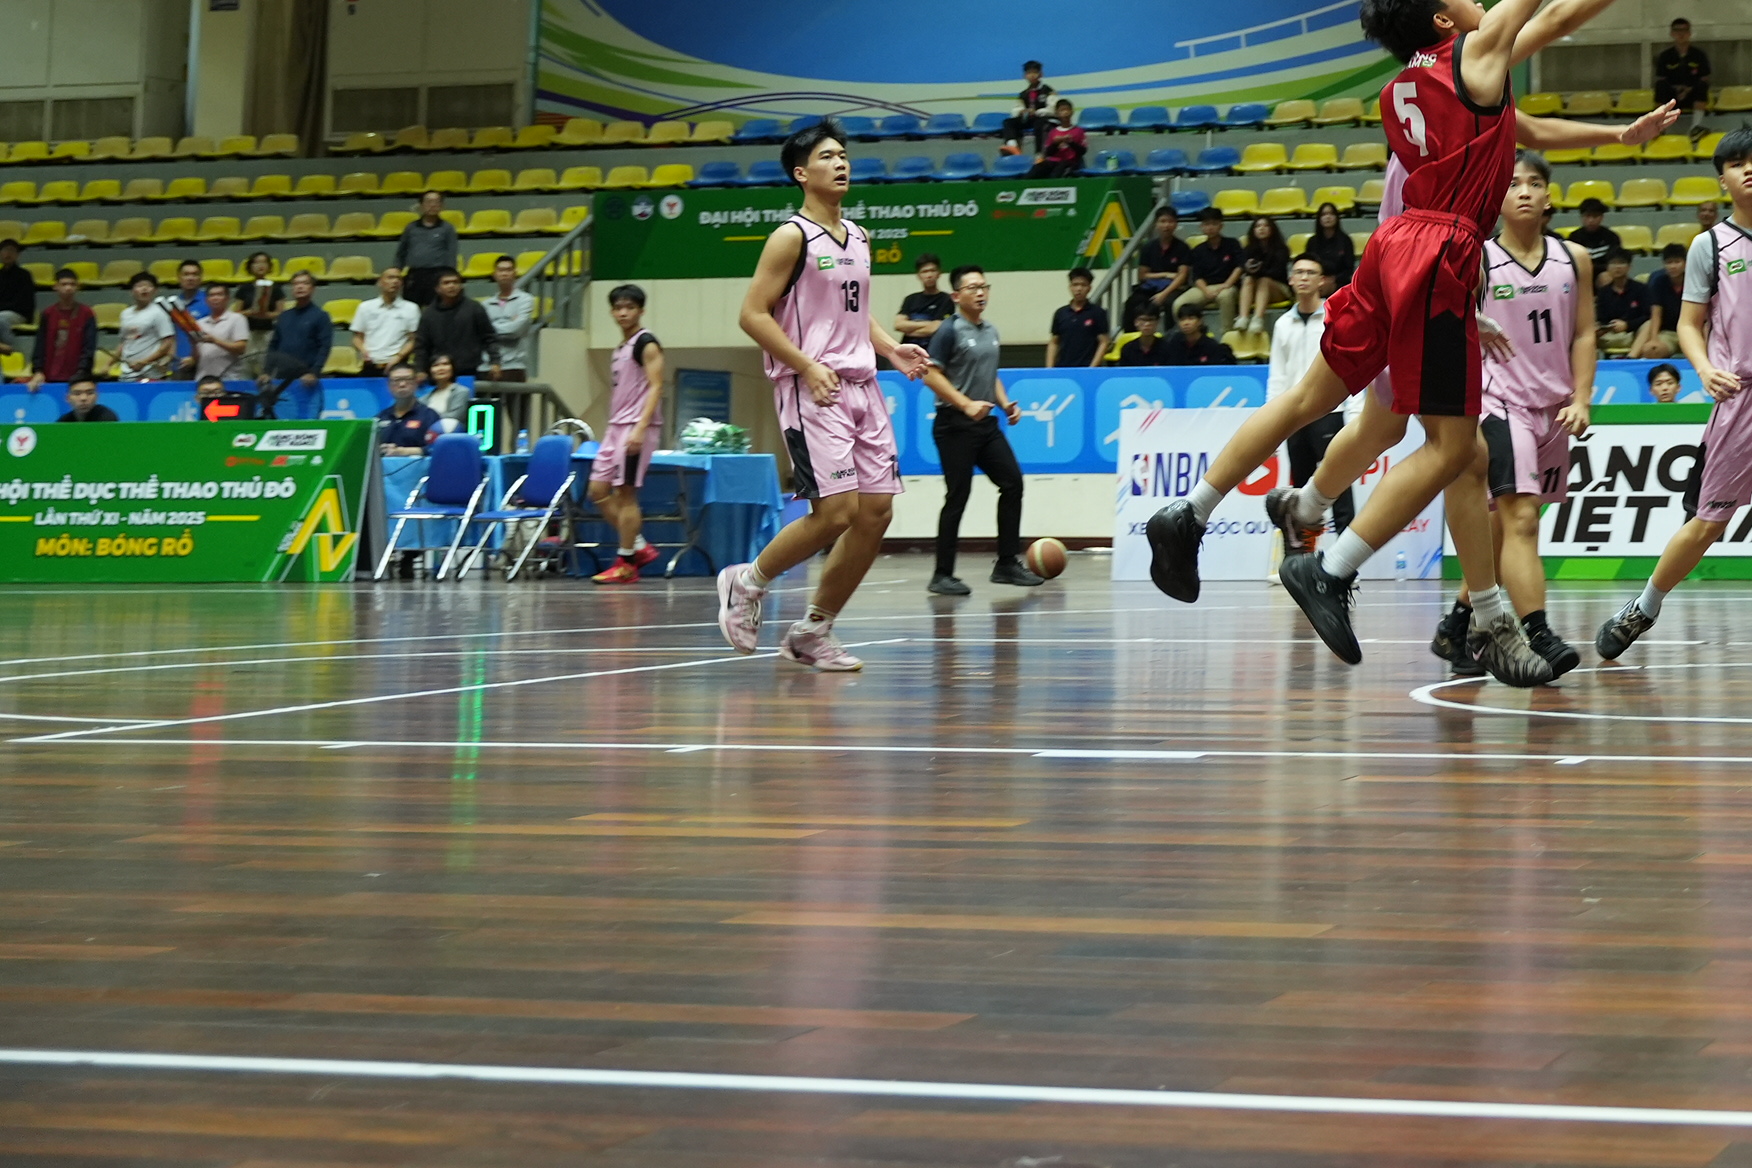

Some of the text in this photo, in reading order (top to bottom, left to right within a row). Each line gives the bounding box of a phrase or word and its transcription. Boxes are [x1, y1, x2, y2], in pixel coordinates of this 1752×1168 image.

[1392, 81, 1430, 158] 5
[699, 210, 728, 228] ĐẠI
[730, 207, 760, 228] HỘI
[868, 205, 915, 219] THAO
[952, 200, 979, 217] ĐÔ
[875, 242, 902, 264] RỔ
[841, 280, 860, 312] 13
[1527, 308, 1553, 344] 11
[1359, 455, 1389, 485] Pl
[1567, 432, 1703, 493] ĂNG
[72, 481, 117, 506] DỤC
[161, 481, 219, 499] THAO
[220, 475, 263, 499] THỦ
[263, 476, 297, 499] ĐÔ
[1541, 465, 1561, 494] 11
[34, 506, 69, 526] LẦN
[68, 508, 104, 526] THỨ
[101, 511, 121, 526] XI
[127, 508, 165, 526] NĂM
[166, 511, 206, 525] 2025
[1205, 518, 1240, 539] ĐỘC
[1400, 519, 1430, 533] LAY
[1541, 477, 1671, 552] IỆT
[35, 528, 195, 557] MÔN: BÓNG RỔ
